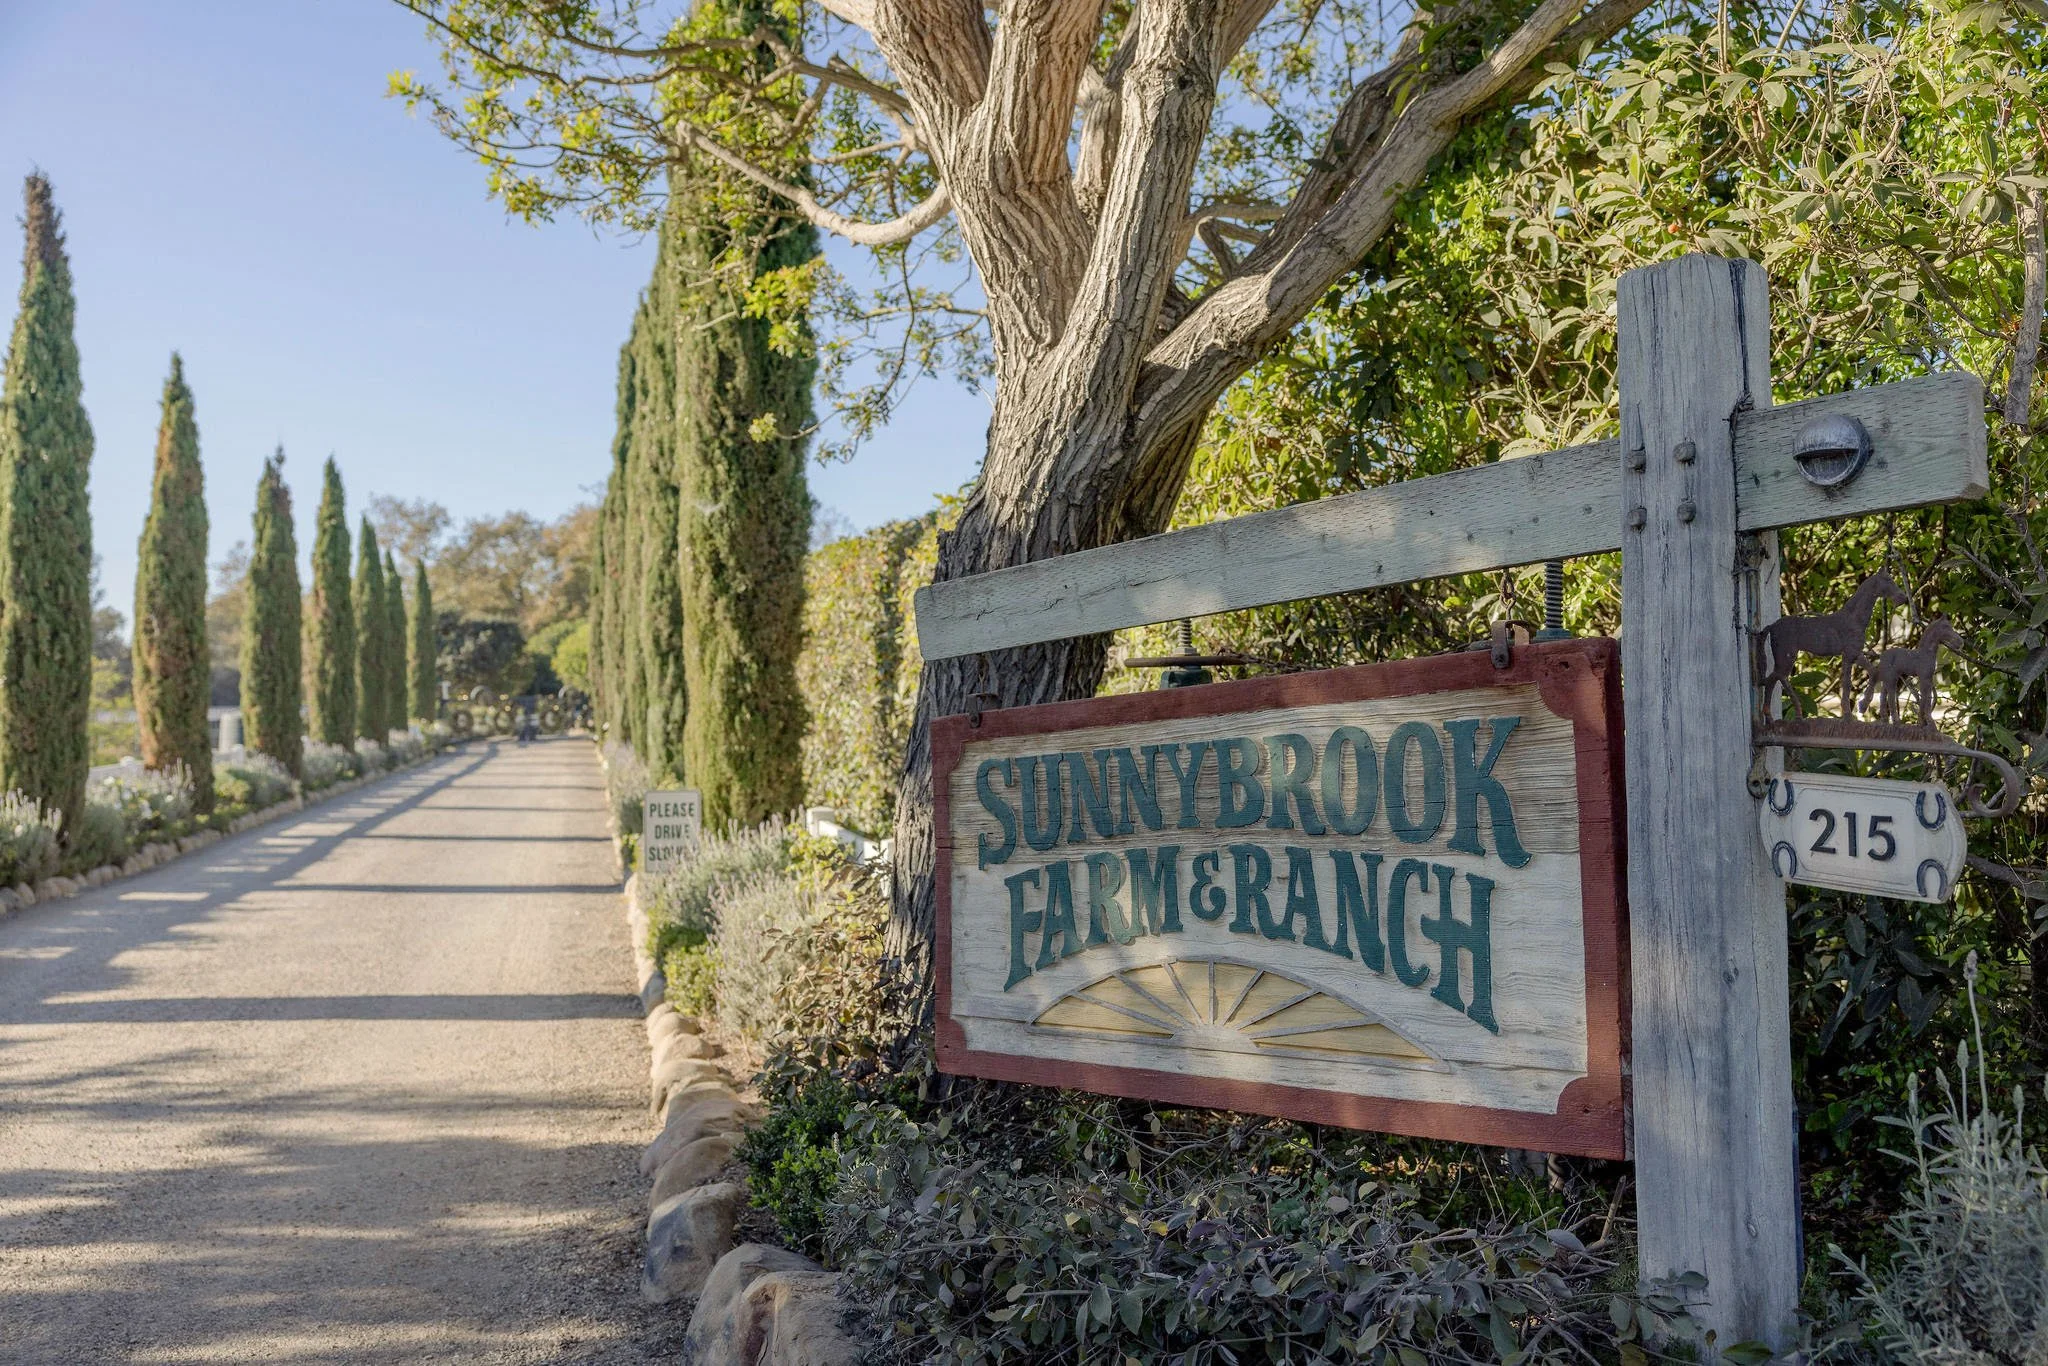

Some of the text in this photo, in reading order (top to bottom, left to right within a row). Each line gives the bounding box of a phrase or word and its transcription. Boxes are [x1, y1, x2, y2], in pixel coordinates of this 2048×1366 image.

[649, 802, 695, 818] PLEASE
[976, 716, 1533, 871] SUNNYBROOK
[654, 824, 690, 840] DRIVE
[1808, 808, 1896, 861] 215
[1229, 843, 1499, 1036] RANCH
